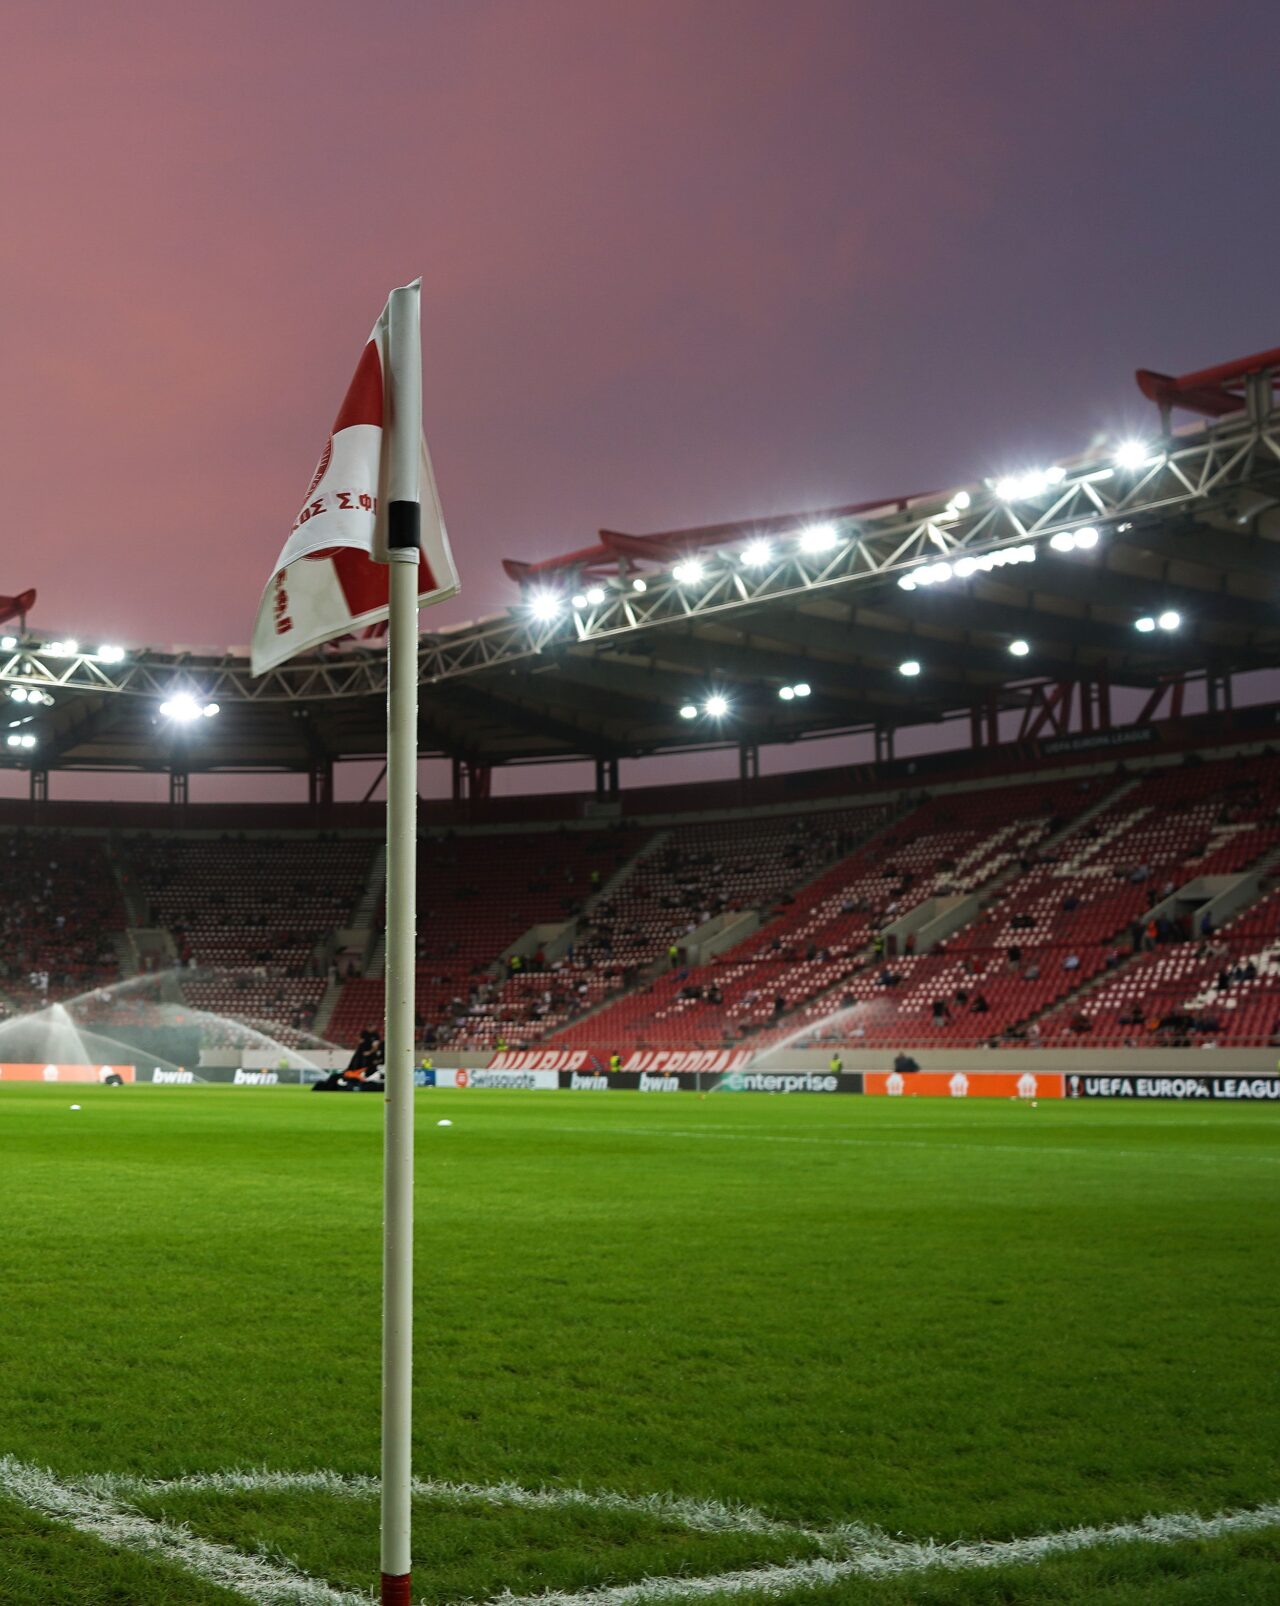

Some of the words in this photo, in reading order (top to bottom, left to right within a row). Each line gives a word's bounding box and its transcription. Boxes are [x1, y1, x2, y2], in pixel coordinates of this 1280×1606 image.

[152, 1067, 193, 1084] bwin
[234, 1068, 279, 1085] bwin
[471, 1070, 536, 1089] Swissquote
[571, 1071, 608, 1090] bwin
[639, 1072, 679, 1091] bwin
[730, 1072, 838, 1092] enterprise
[1085, 1077, 1133, 1096] UEFA
[1136, 1078, 1210, 1097] EUROPA
